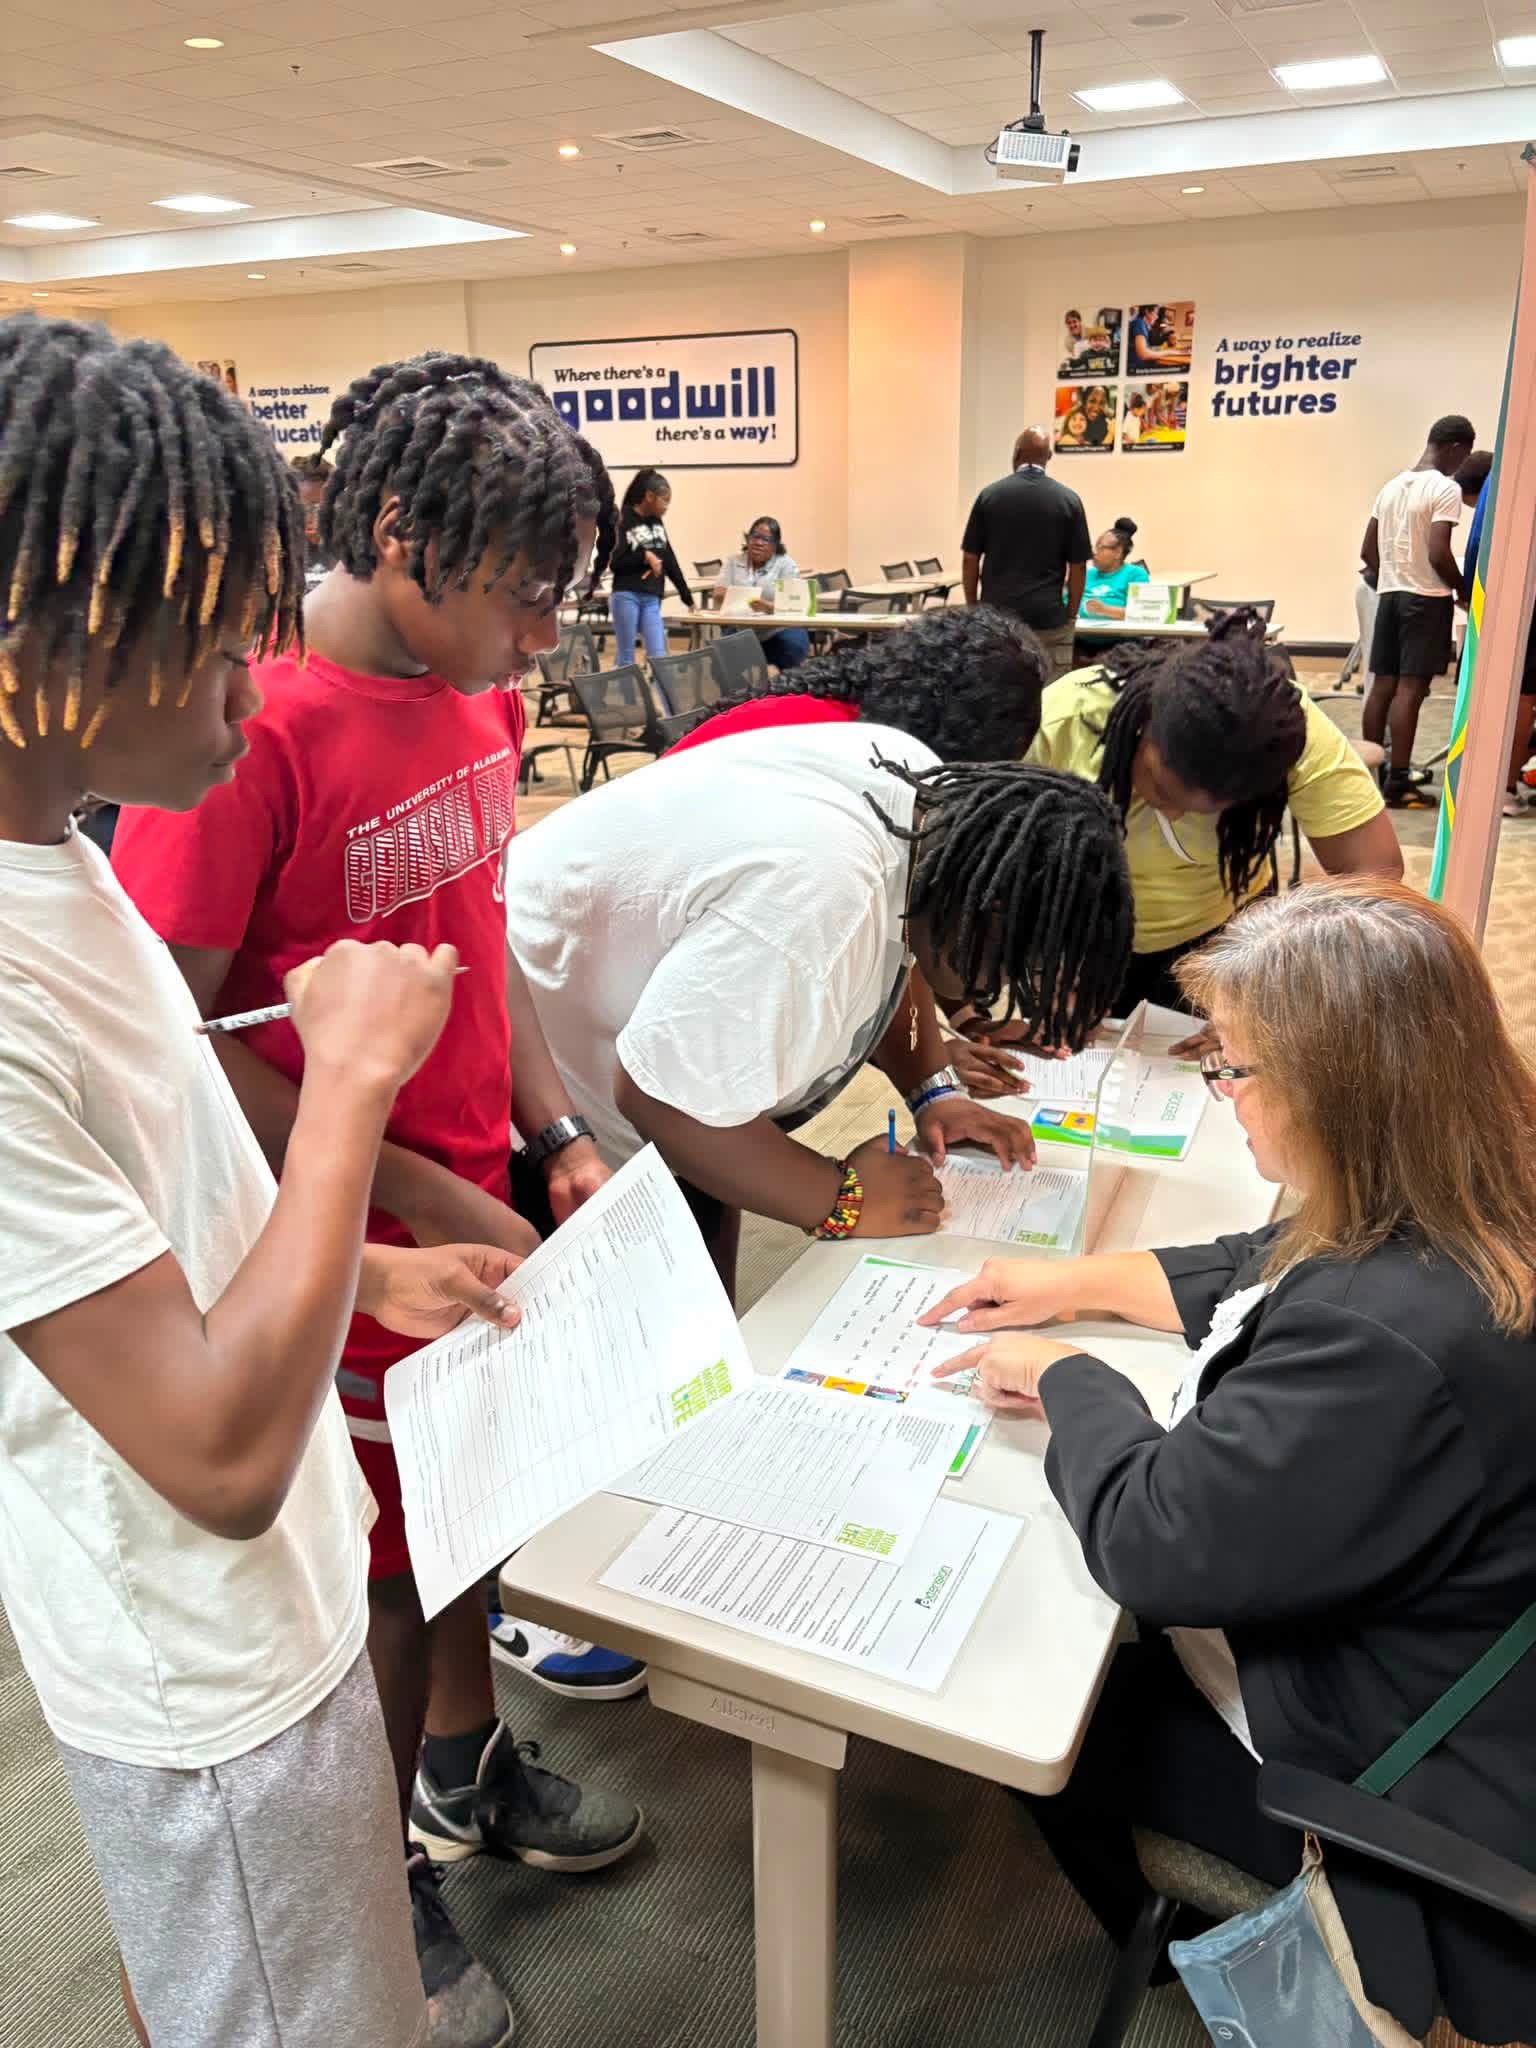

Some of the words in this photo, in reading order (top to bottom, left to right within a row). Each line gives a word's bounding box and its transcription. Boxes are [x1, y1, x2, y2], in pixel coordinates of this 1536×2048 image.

[1216, 338, 1229, 353] A
[1233, 339, 1271, 353] way
[1275, 335, 1294, 349] to
[1297, 331, 1362, 349] realize
[554, 368, 602, 383] Where
[603, 365, 654, 380] there's
[656, 367, 666, 378] a
[1214, 353, 1357, 390] brighter
[248, 387, 257, 397] A
[280, 387, 290, 396] to
[553, 366, 775, 432] goodwill
[251, 401, 307, 420] better
[1211, 390, 1337, 417] futures
[656, 425, 712, 441] there's
[714, 429, 726, 440] a
[345, 815, 381, 839] THE
[386, 774, 455, 820] UNIVERSITY
[456, 766, 470, 780] OF
[473, 747, 512, 773] ALABAMA
